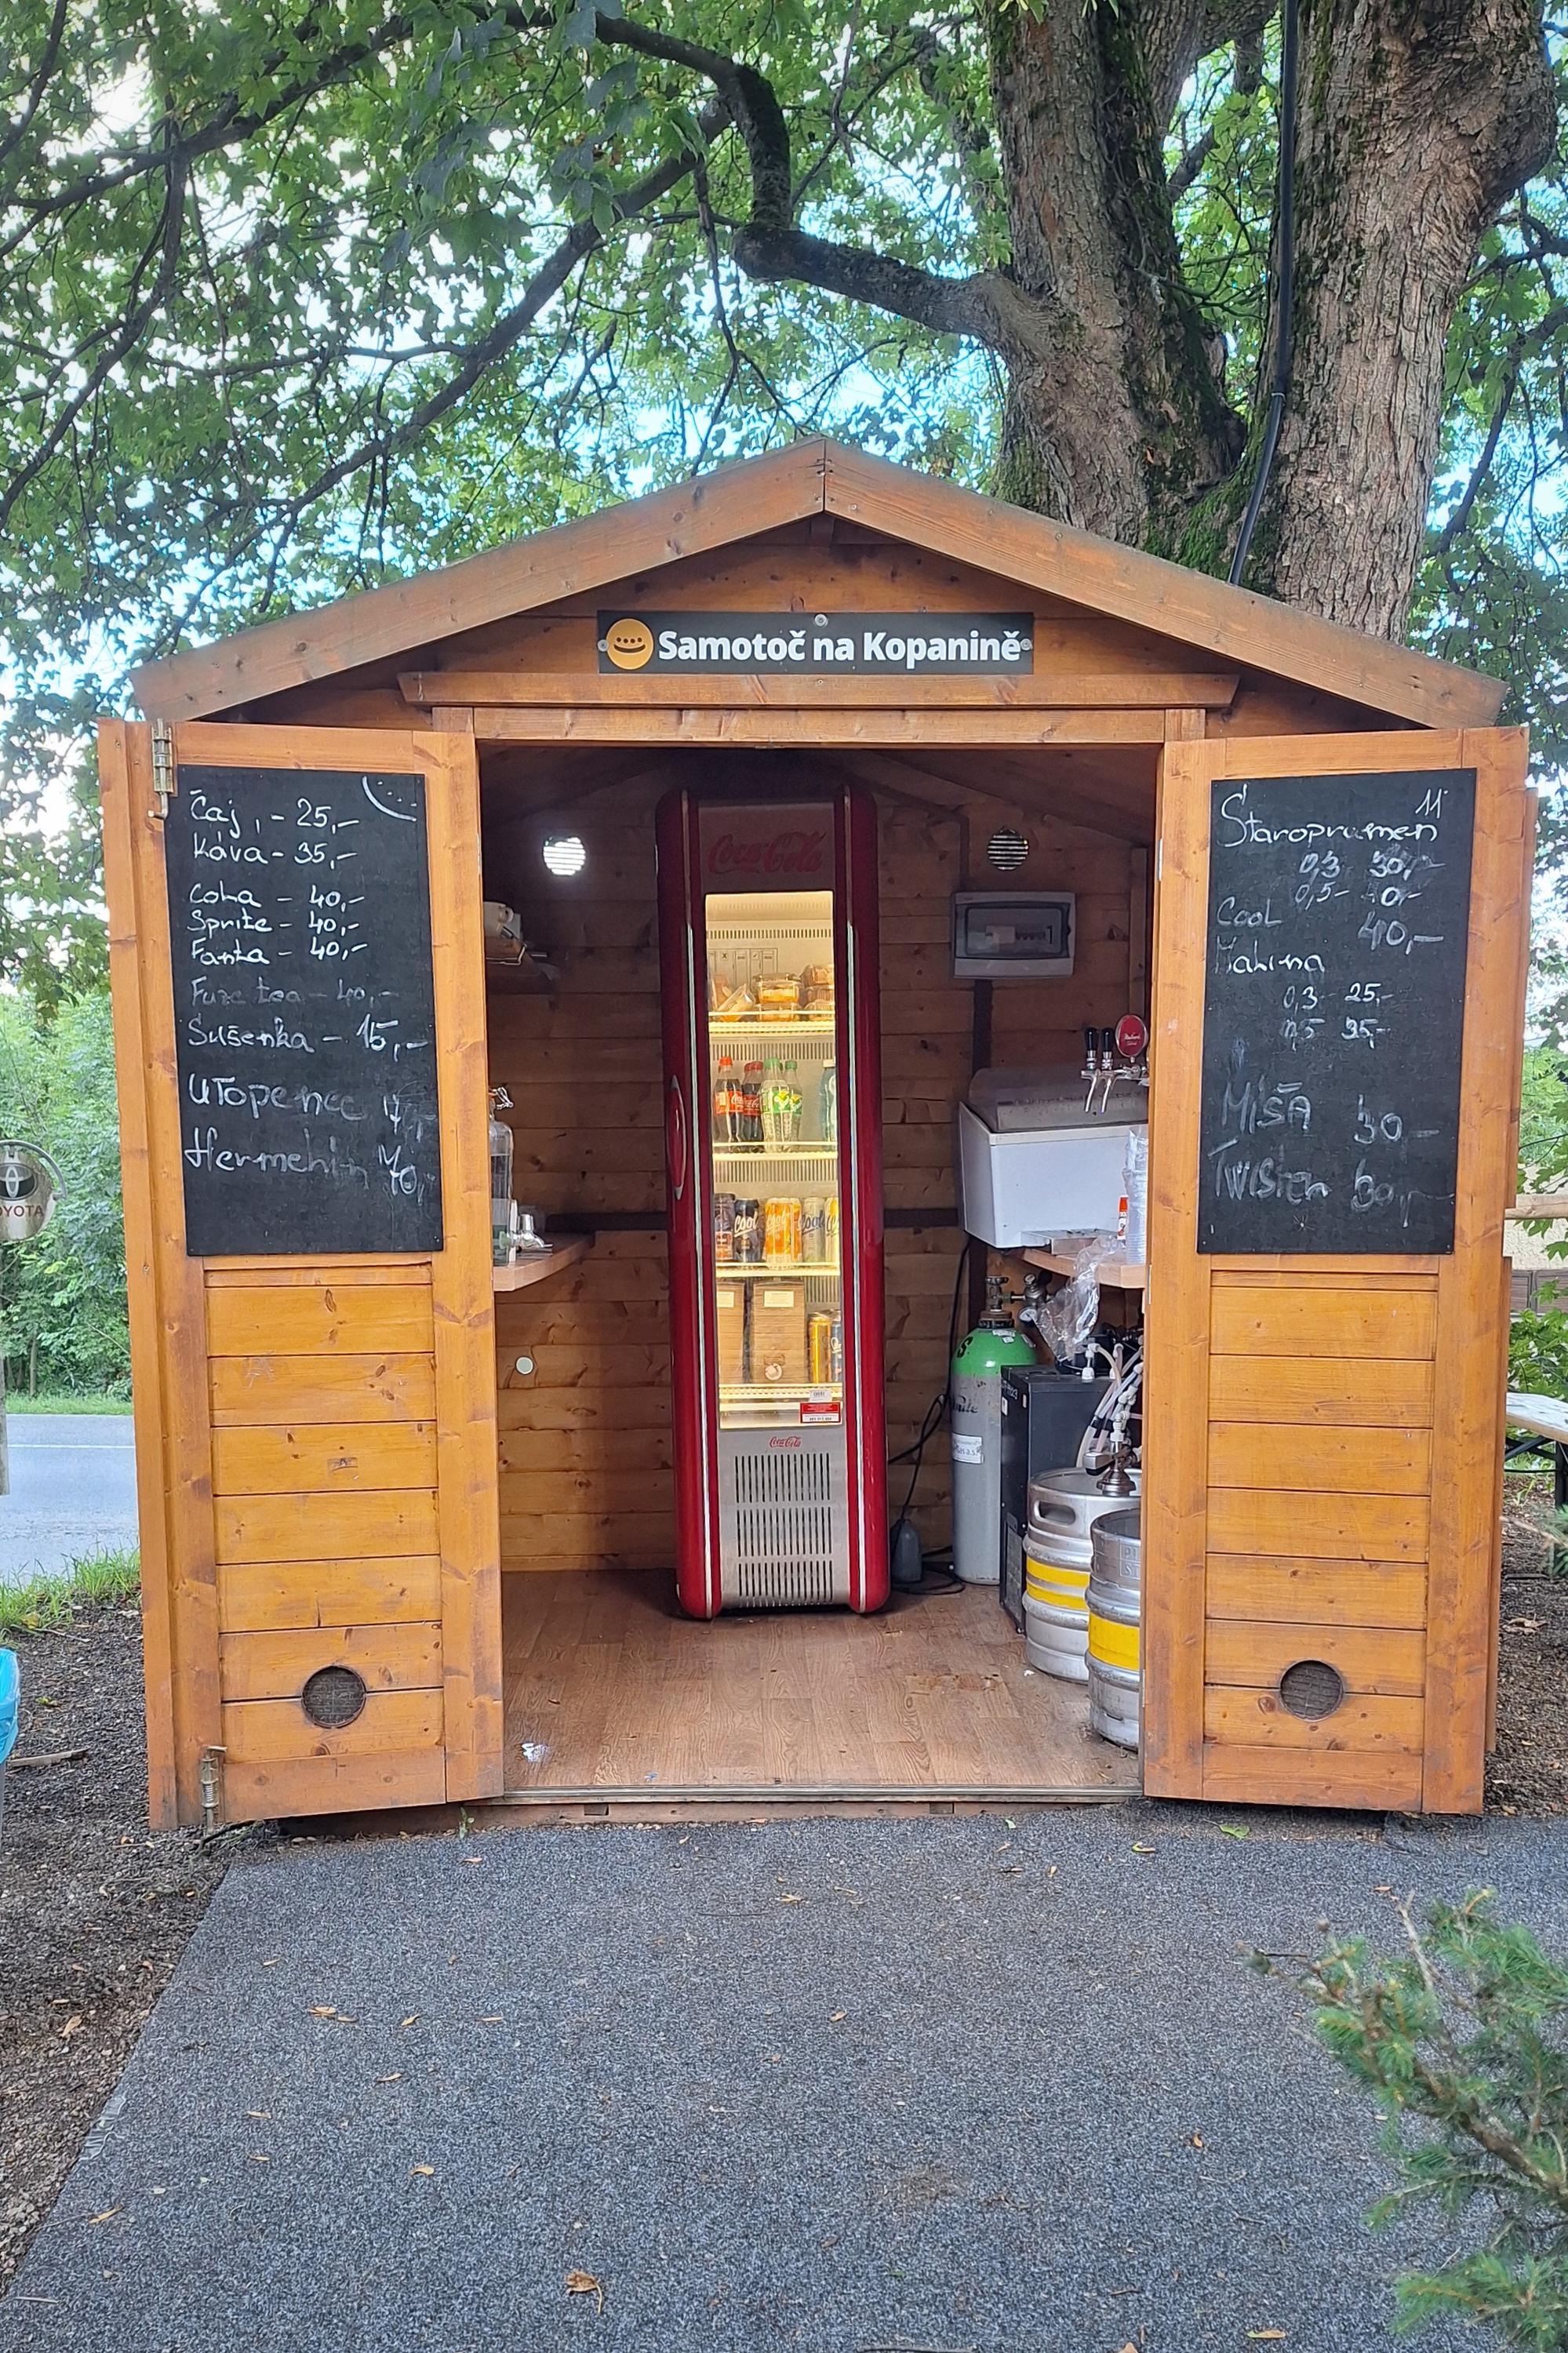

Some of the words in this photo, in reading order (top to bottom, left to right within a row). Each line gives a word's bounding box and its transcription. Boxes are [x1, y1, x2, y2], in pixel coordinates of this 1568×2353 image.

[658, 630, 806, 661] Samotoč
[813, 635, 855, 661] na
[864, 630, 1021, 669] Kopanině
[1217, 784, 1438, 848] Staropramen
[187, 907, 273, 939] Sprite
[191, 936, 271, 966] Fanta
[256, 976, 303, 1005] tea
